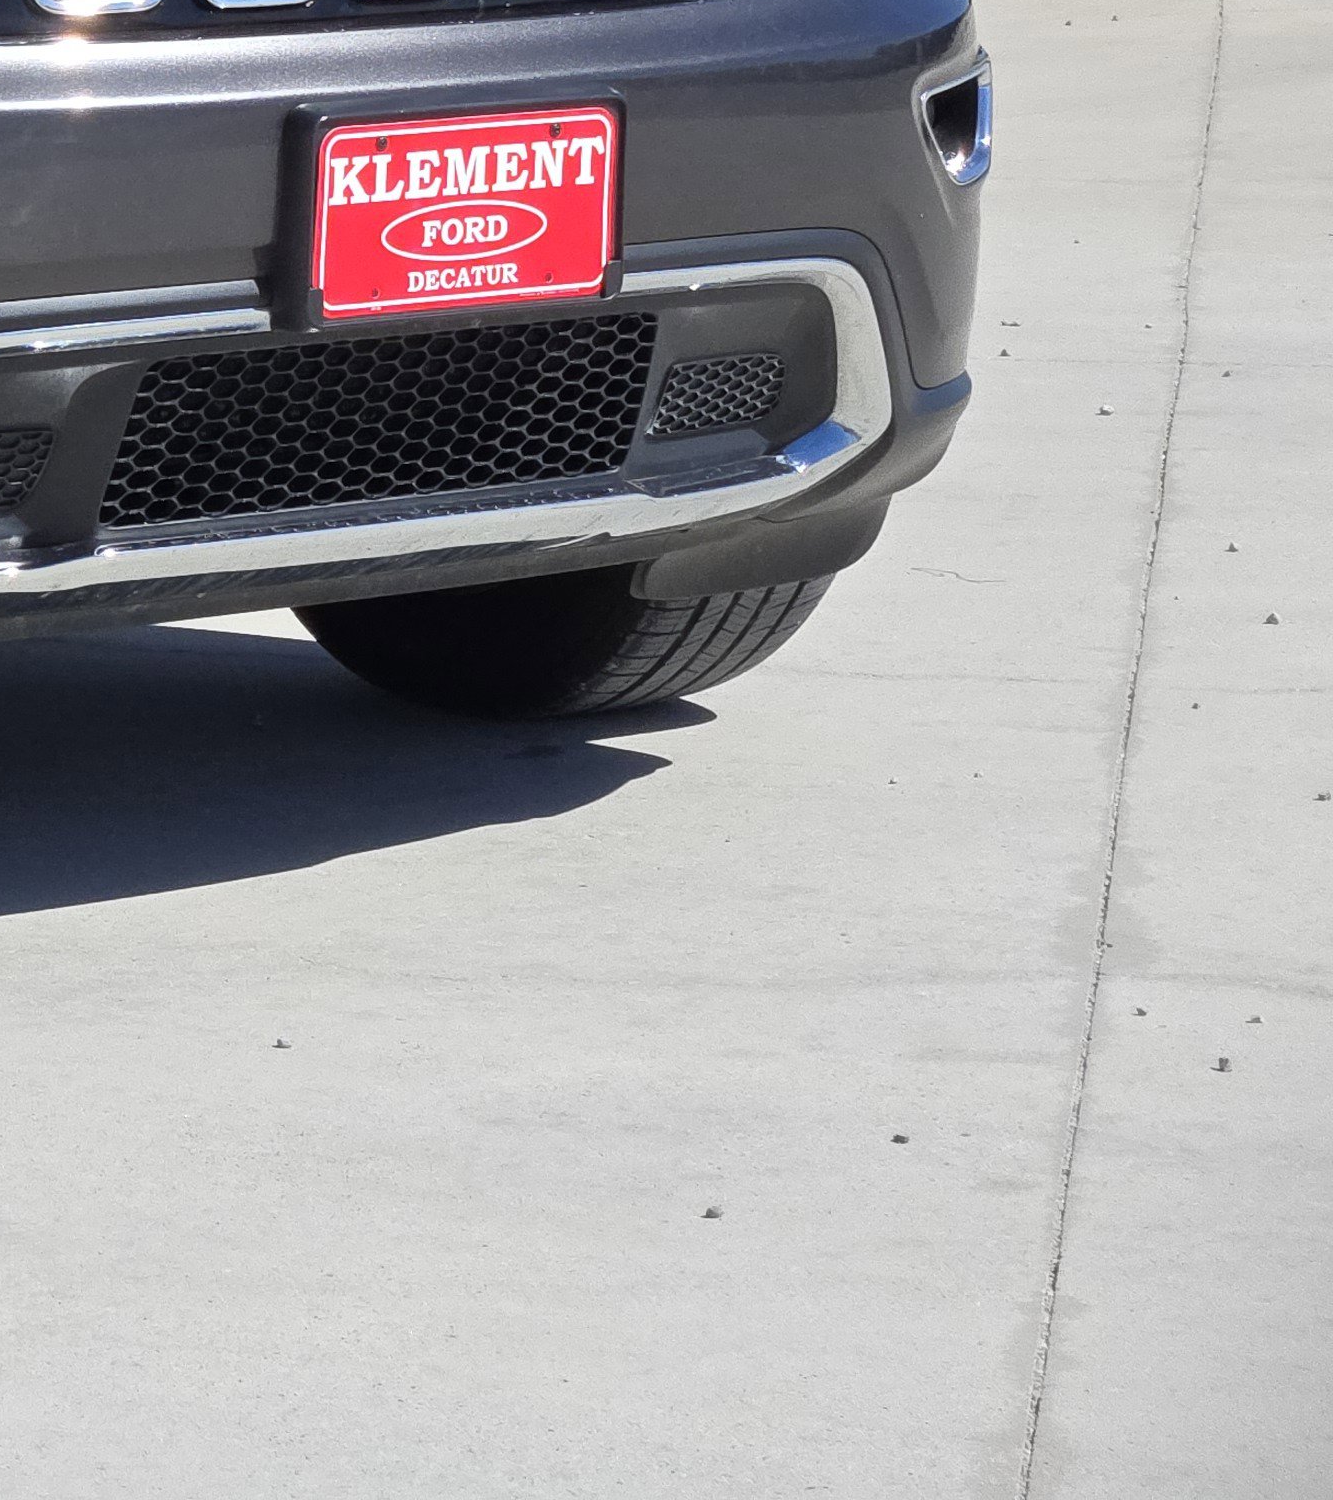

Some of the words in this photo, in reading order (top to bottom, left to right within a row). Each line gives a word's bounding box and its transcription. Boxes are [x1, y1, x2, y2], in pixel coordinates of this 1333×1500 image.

[328, 135, 604, 206] KLEMENT
[421, 214, 509, 248] FORD
[407, 263, 519, 293] DECATUR
